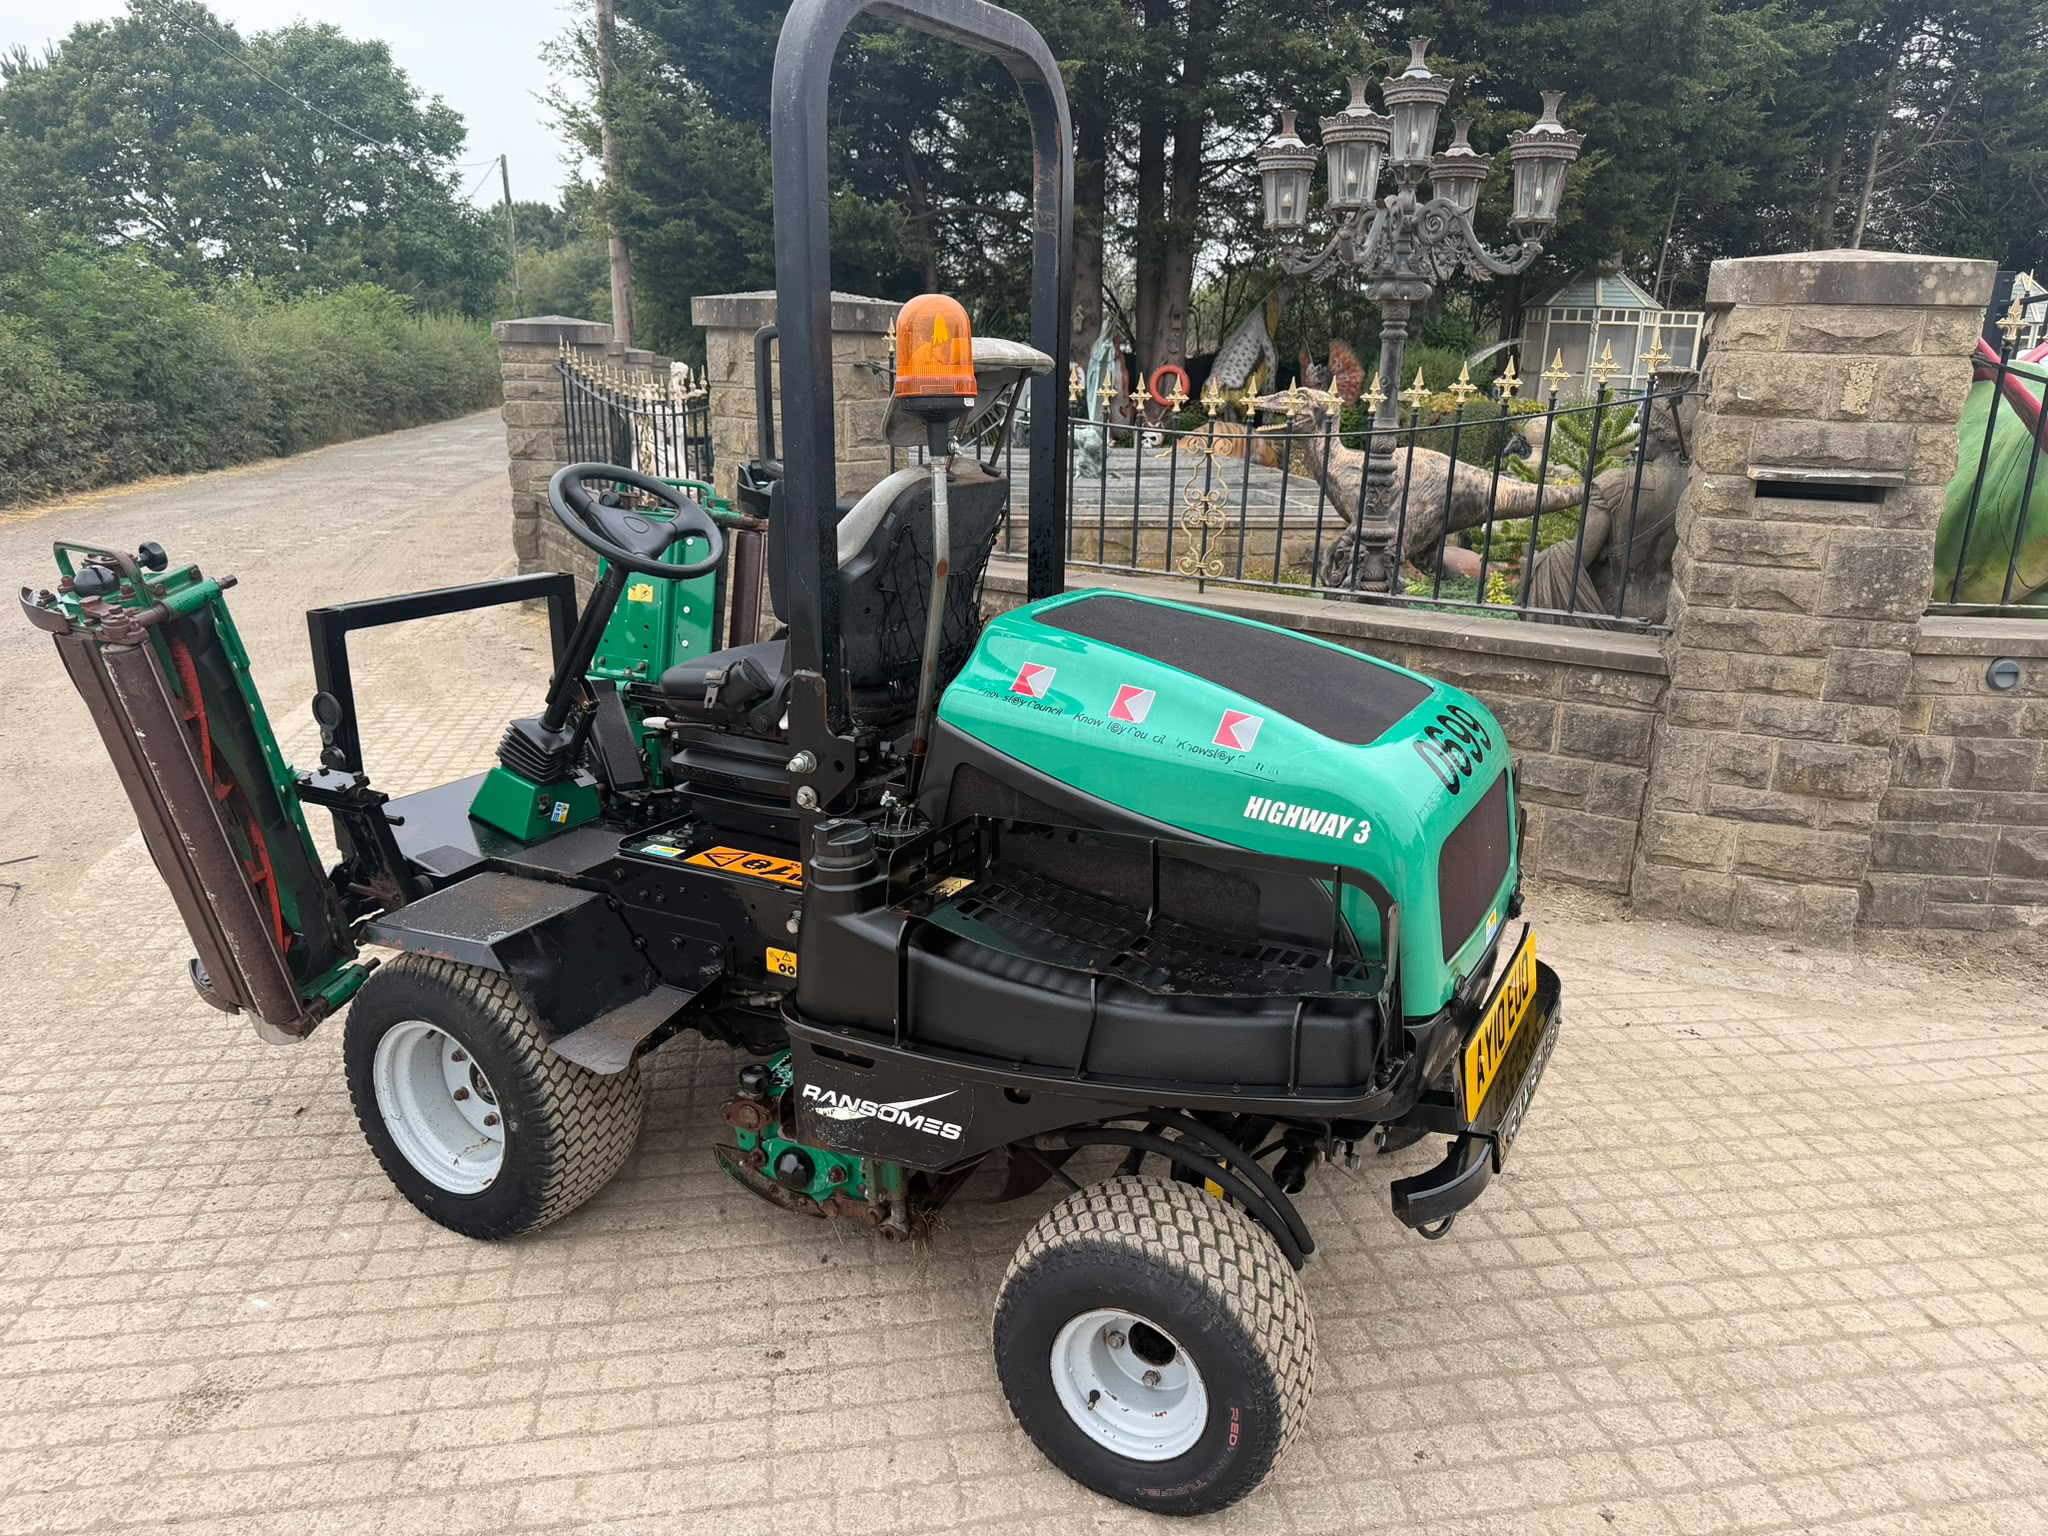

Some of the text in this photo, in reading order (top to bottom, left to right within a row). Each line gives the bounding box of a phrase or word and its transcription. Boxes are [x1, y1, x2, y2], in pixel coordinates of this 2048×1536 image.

[1027, 700, 1064, 717] Council
[1128, 726, 1167, 744] Coucil
[1413, 704, 1492, 796] 0699
[1243, 795, 1372, 844] HIGHWAY 3
[1477, 997, 1506, 1094] AY10
[802, 1083, 963, 1140] RANSOMES
